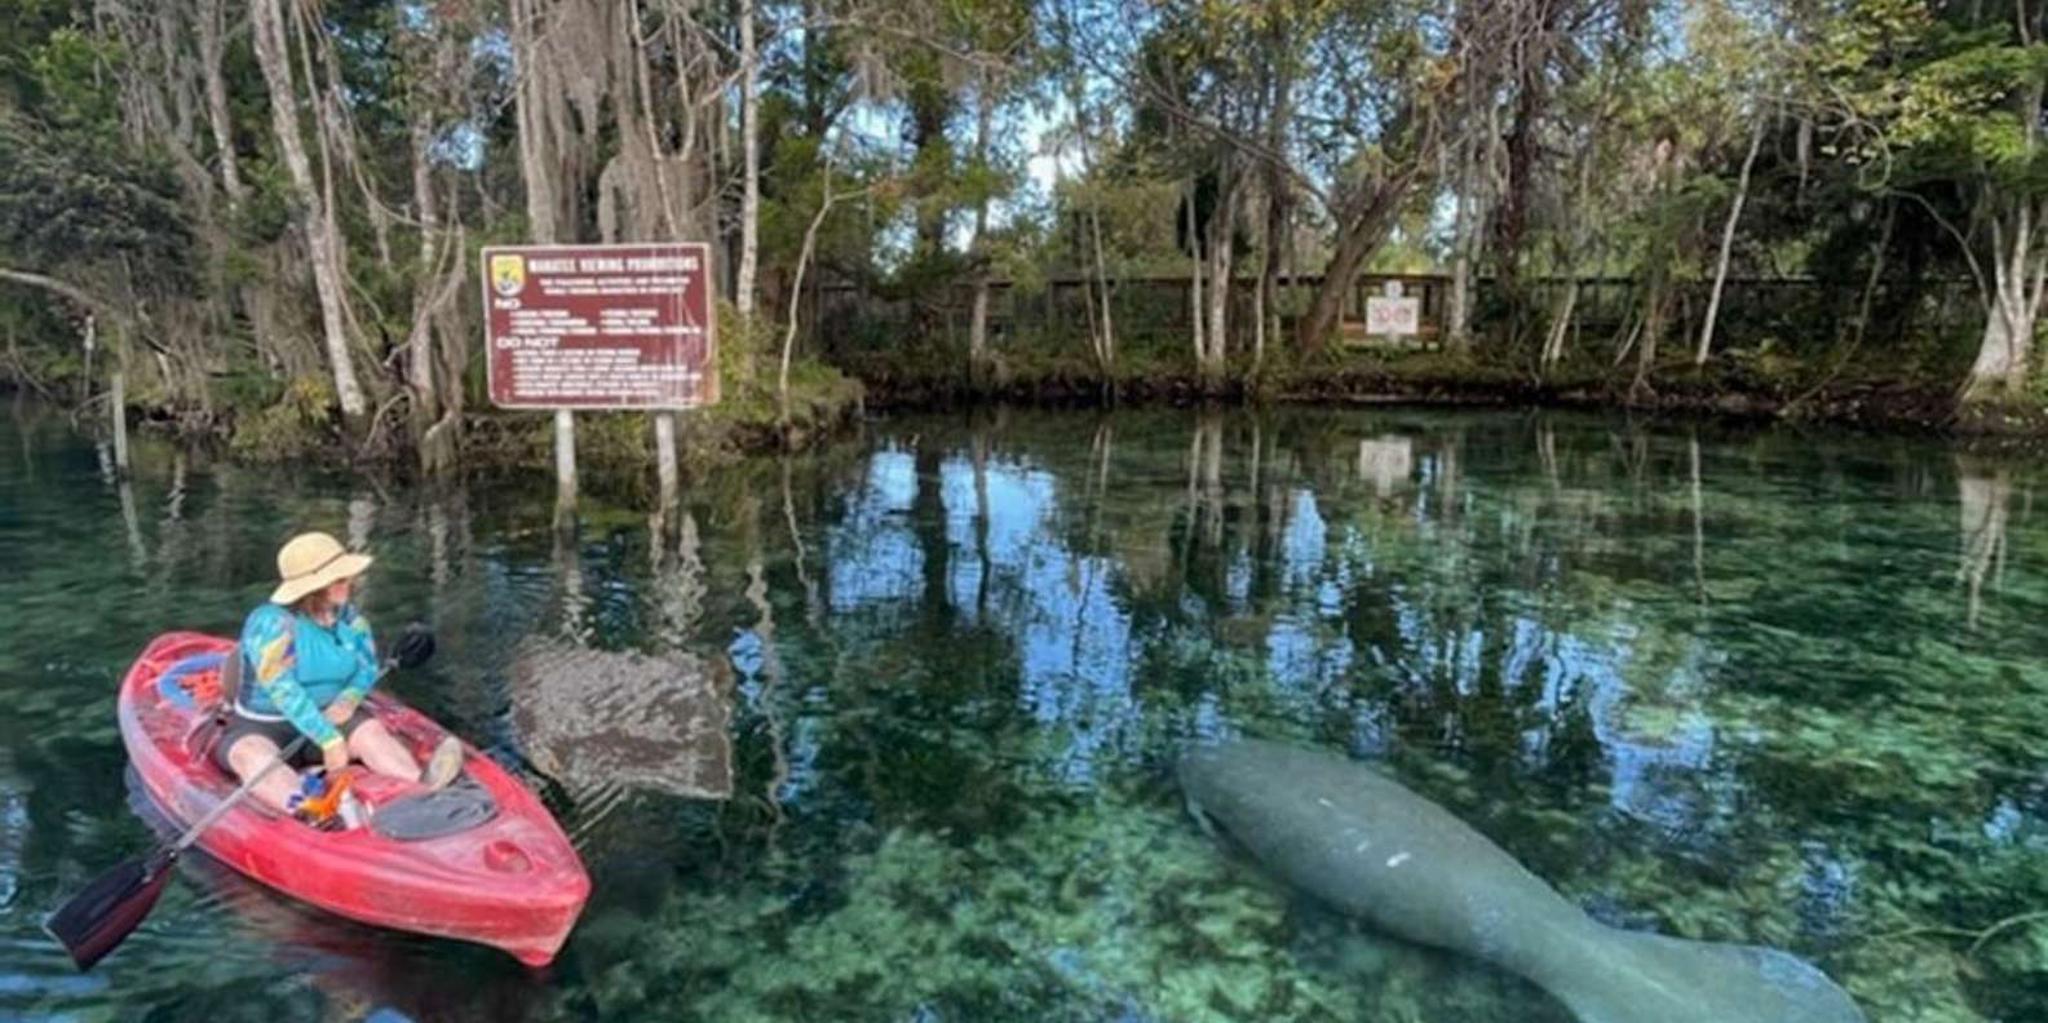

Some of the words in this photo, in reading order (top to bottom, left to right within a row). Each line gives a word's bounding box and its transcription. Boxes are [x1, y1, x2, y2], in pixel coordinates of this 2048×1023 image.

[494, 299, 521, 309] NO
[497, 337, 521, 348] DO
[525, 336, 560, 348] NOT
